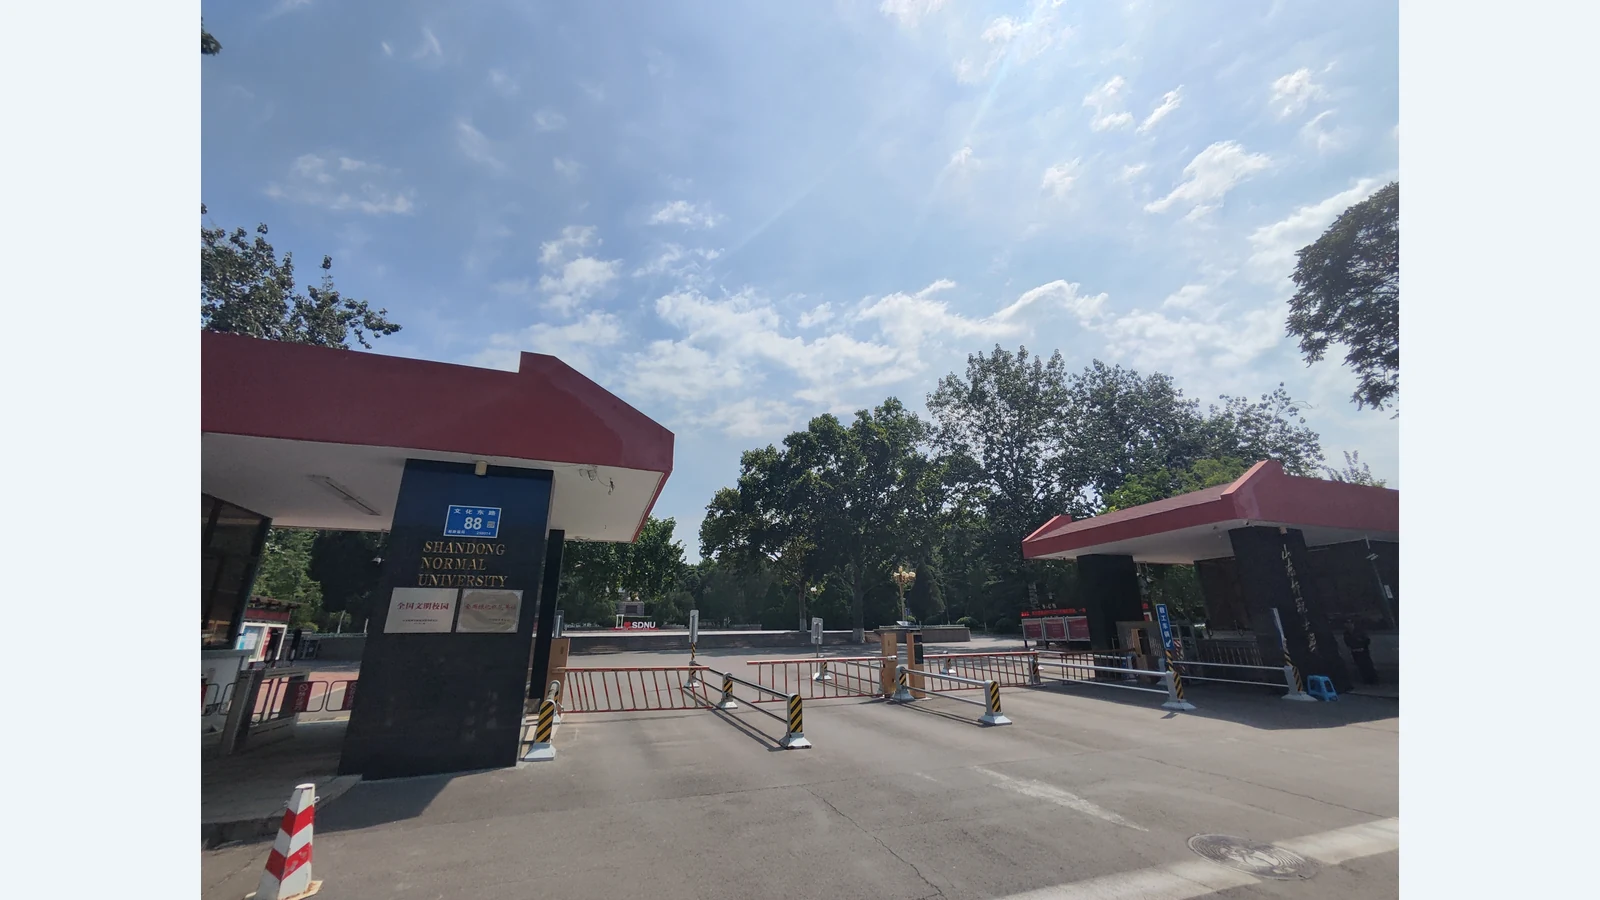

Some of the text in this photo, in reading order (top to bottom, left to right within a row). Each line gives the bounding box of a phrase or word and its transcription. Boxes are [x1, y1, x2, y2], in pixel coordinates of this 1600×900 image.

[453, 508, 496, 516] 文化东路
[464, 516, 482, 530] 88
[423, 541, 505, 555] SHANDONG
[420, 556, 487, 571] NORMAL
[417, 573, 508, 588] UNIVERSITY
[397, 602, 450, 611] 全国文明校园
